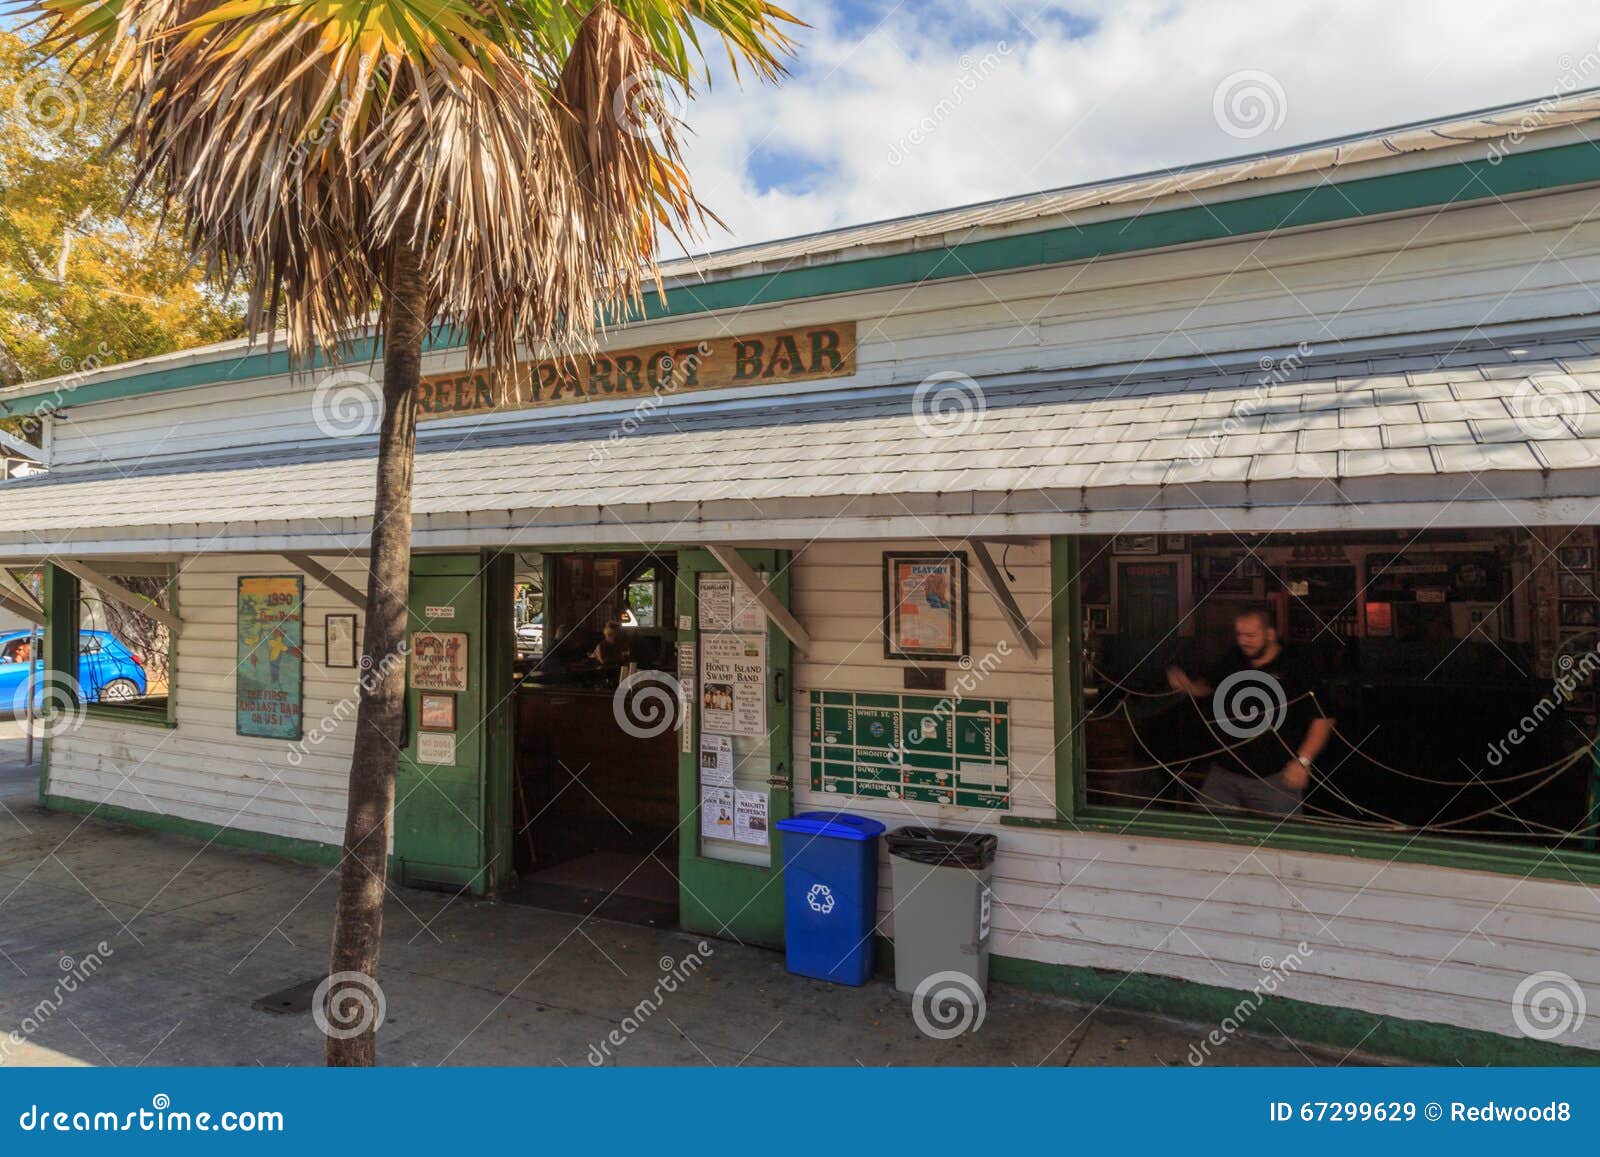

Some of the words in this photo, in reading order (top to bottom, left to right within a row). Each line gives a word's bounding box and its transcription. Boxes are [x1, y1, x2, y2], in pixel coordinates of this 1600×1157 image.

[416, 376, 496, 414] REEN
[529, 344, 700, 402] PARROT
[731, 329, 845, 382] BAR
[911, 565, 947, 575] PLAYBOY
[705, 662, 730, 672] HONEY
[734, 663, 762, 673] ISLAND
[705, 671, 733, 681] SWAMP
[736, 672, 760, 682] BAND
[856, 709, 880, 717] WHITE
